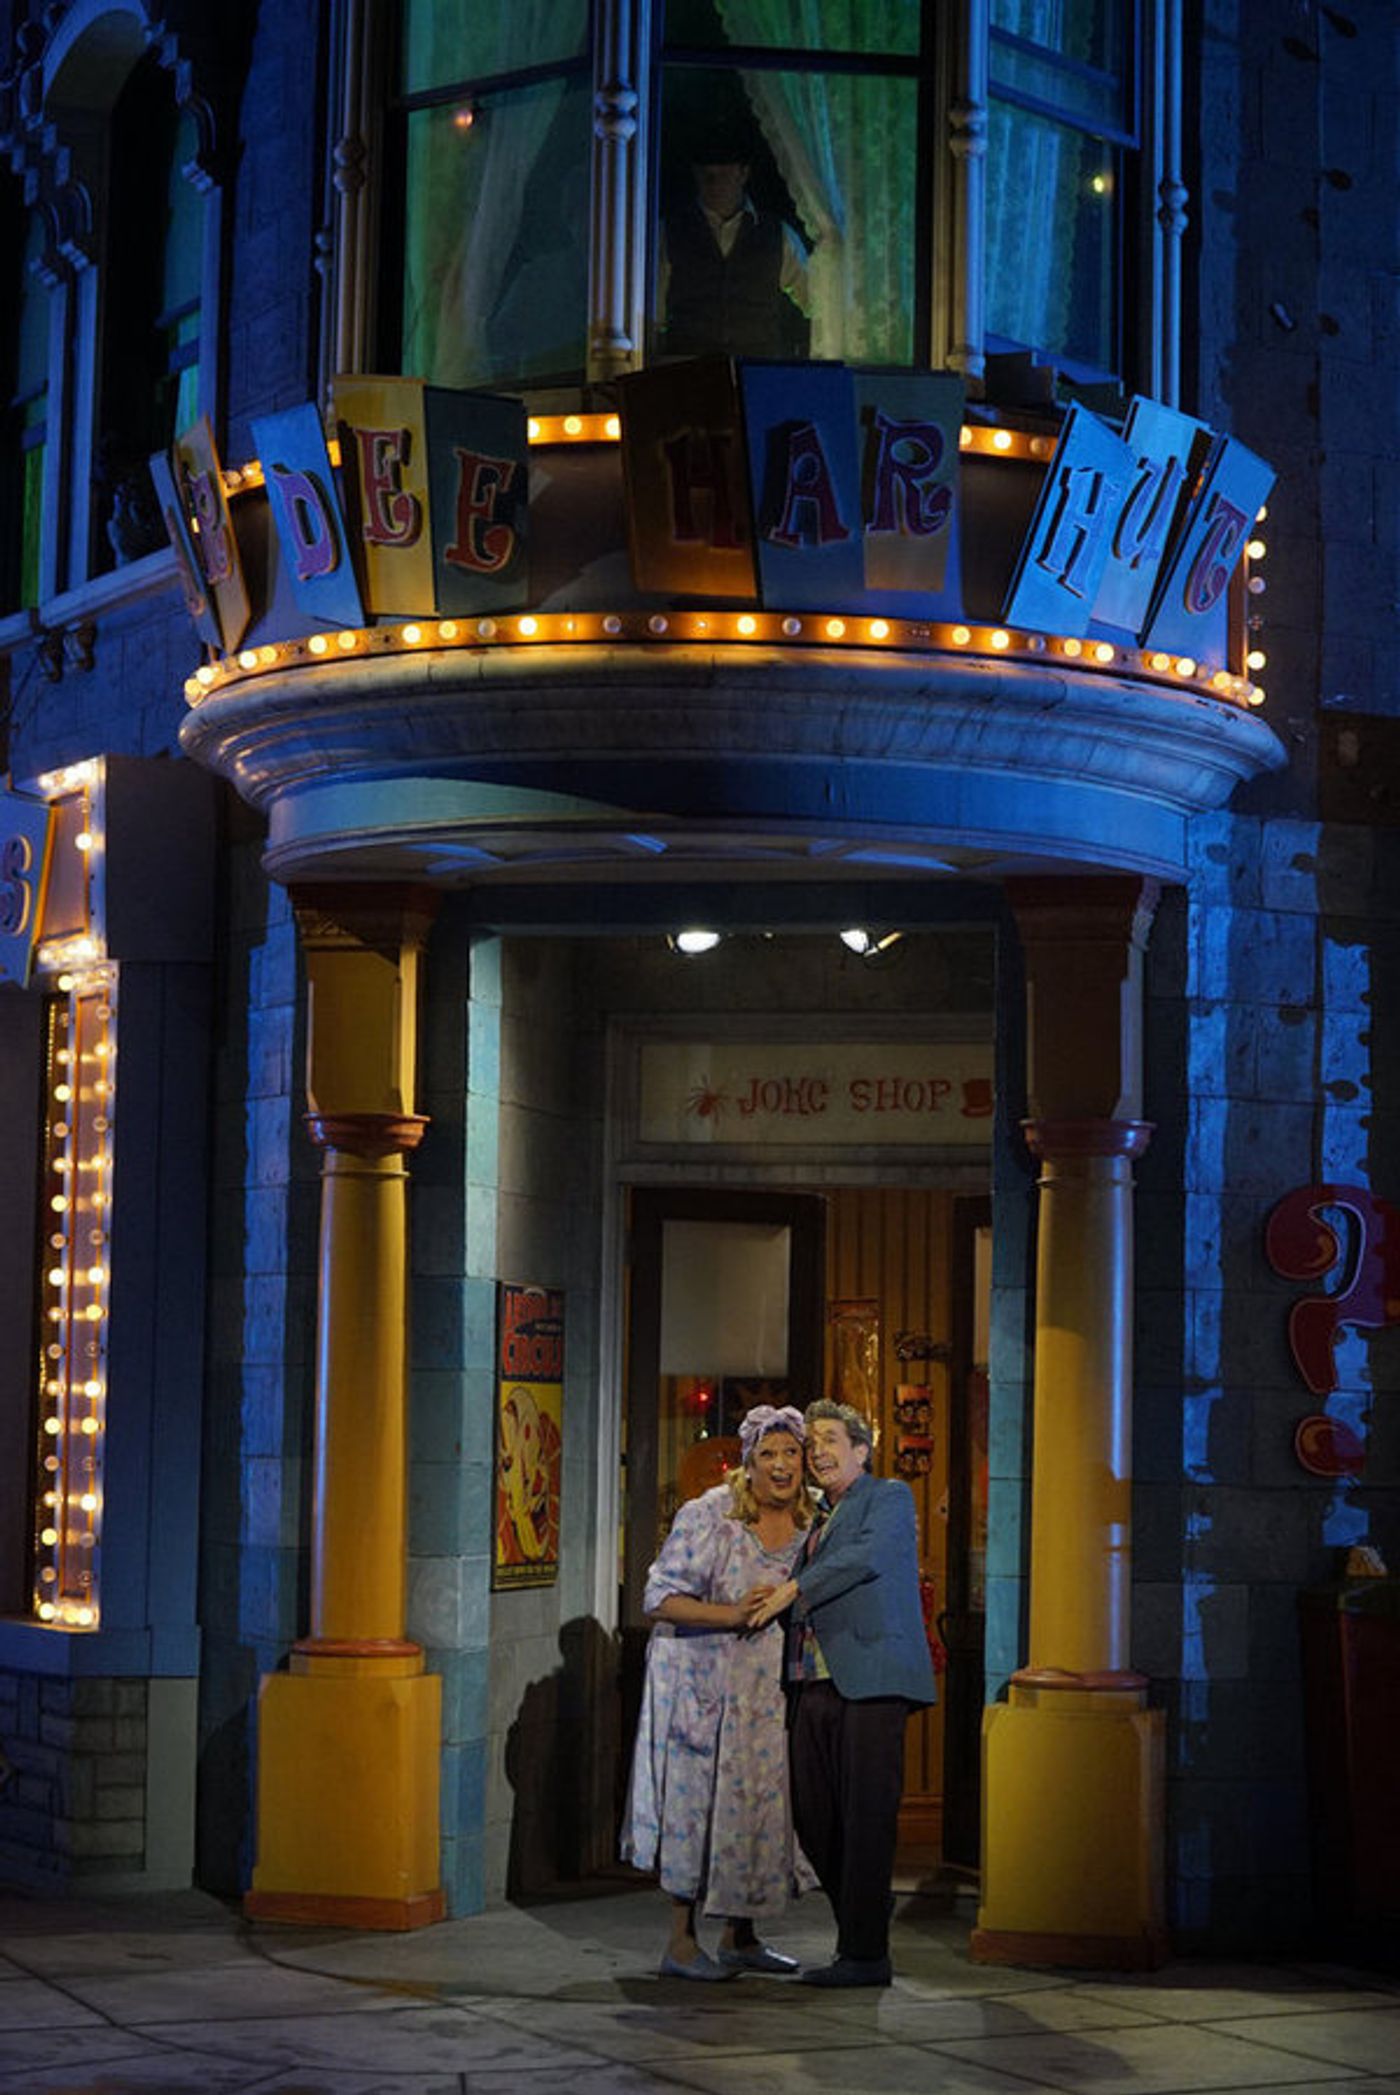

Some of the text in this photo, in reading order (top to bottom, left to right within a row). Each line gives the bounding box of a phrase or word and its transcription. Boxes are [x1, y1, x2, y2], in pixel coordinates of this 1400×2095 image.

[659, 408, 952, 551] HAR
[1036, 453, 1250, 612] HUT
[849, 1078, 952, 1113] SHOP
